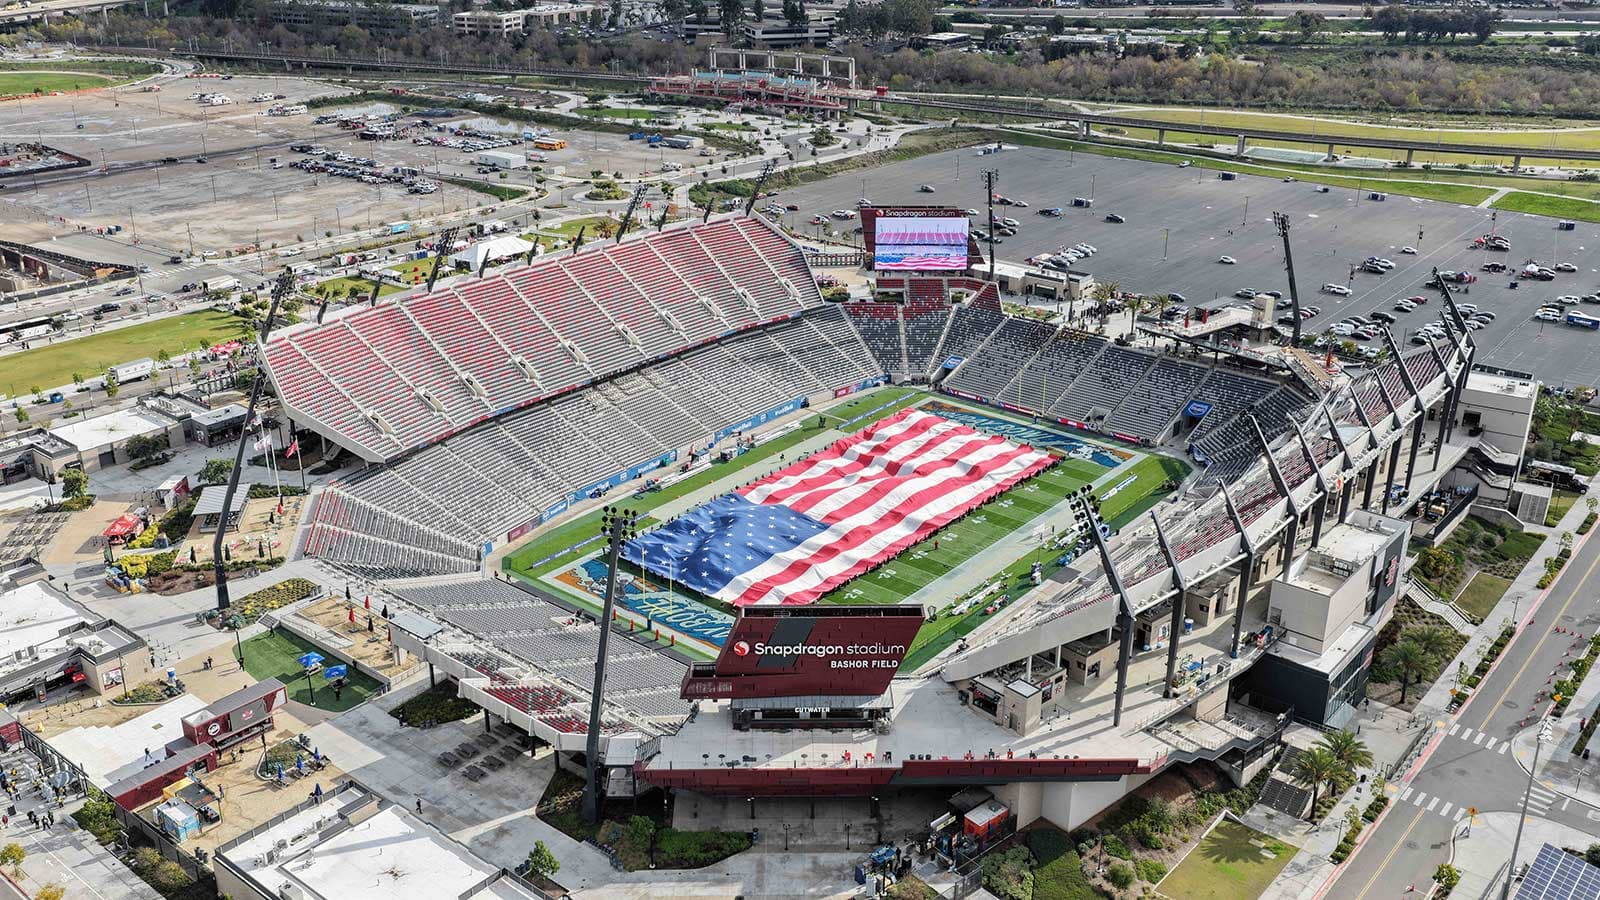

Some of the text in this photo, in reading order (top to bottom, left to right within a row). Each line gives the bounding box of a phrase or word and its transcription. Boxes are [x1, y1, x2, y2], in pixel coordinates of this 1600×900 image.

[885, 209, 956, 218] Snapdragon stadium
[754, 642, 906, 658] Snapdragon stadium
[830, 660, 899, 669] BASHOR FIELD
